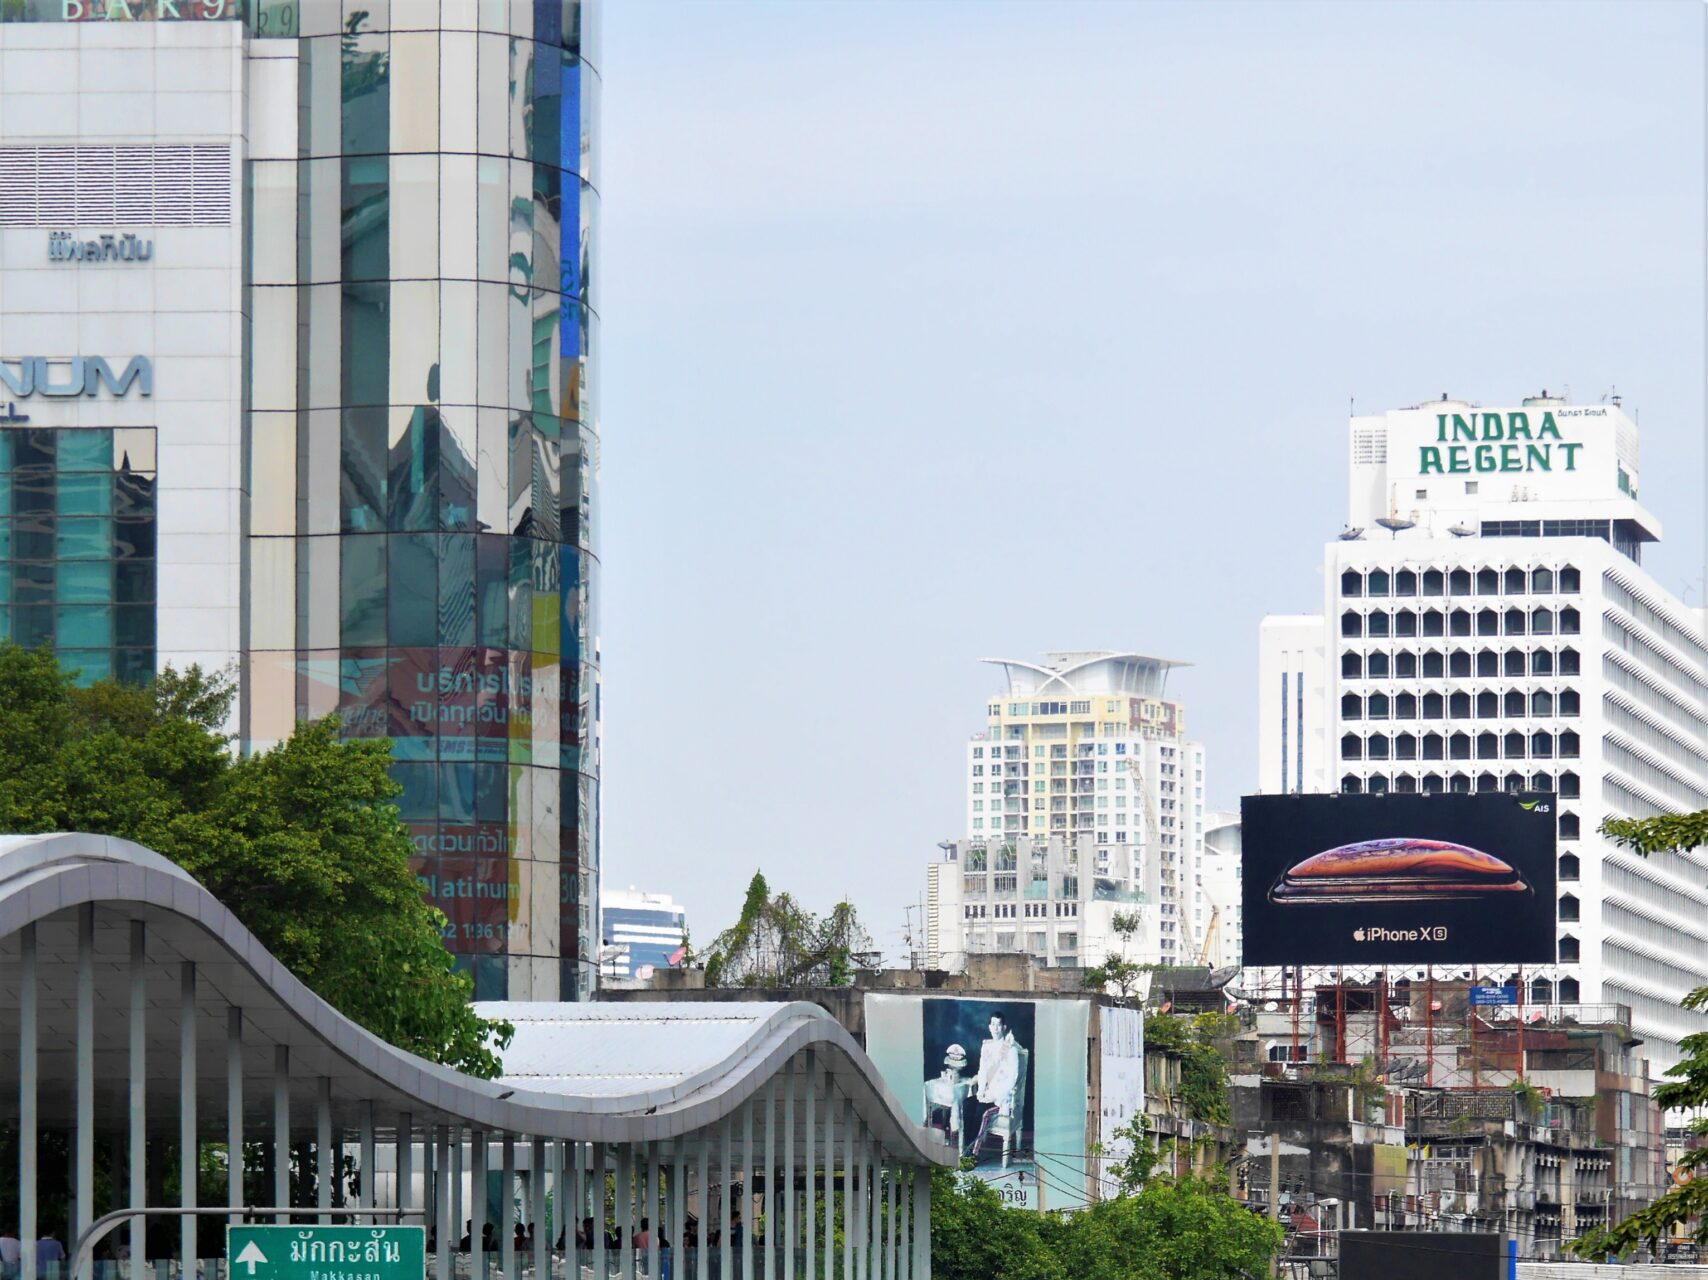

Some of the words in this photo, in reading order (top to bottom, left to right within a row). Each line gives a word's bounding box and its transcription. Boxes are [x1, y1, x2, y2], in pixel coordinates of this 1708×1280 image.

[1436, 411, 1563, 442] INDRA
[1418, 443, 1584, 474] REGENT
[1534, 804, 1549, 813] AIS
[1367, 927, 1418, 941] iPhone
[289, 1230, 401, 1263] มักกะสัน
